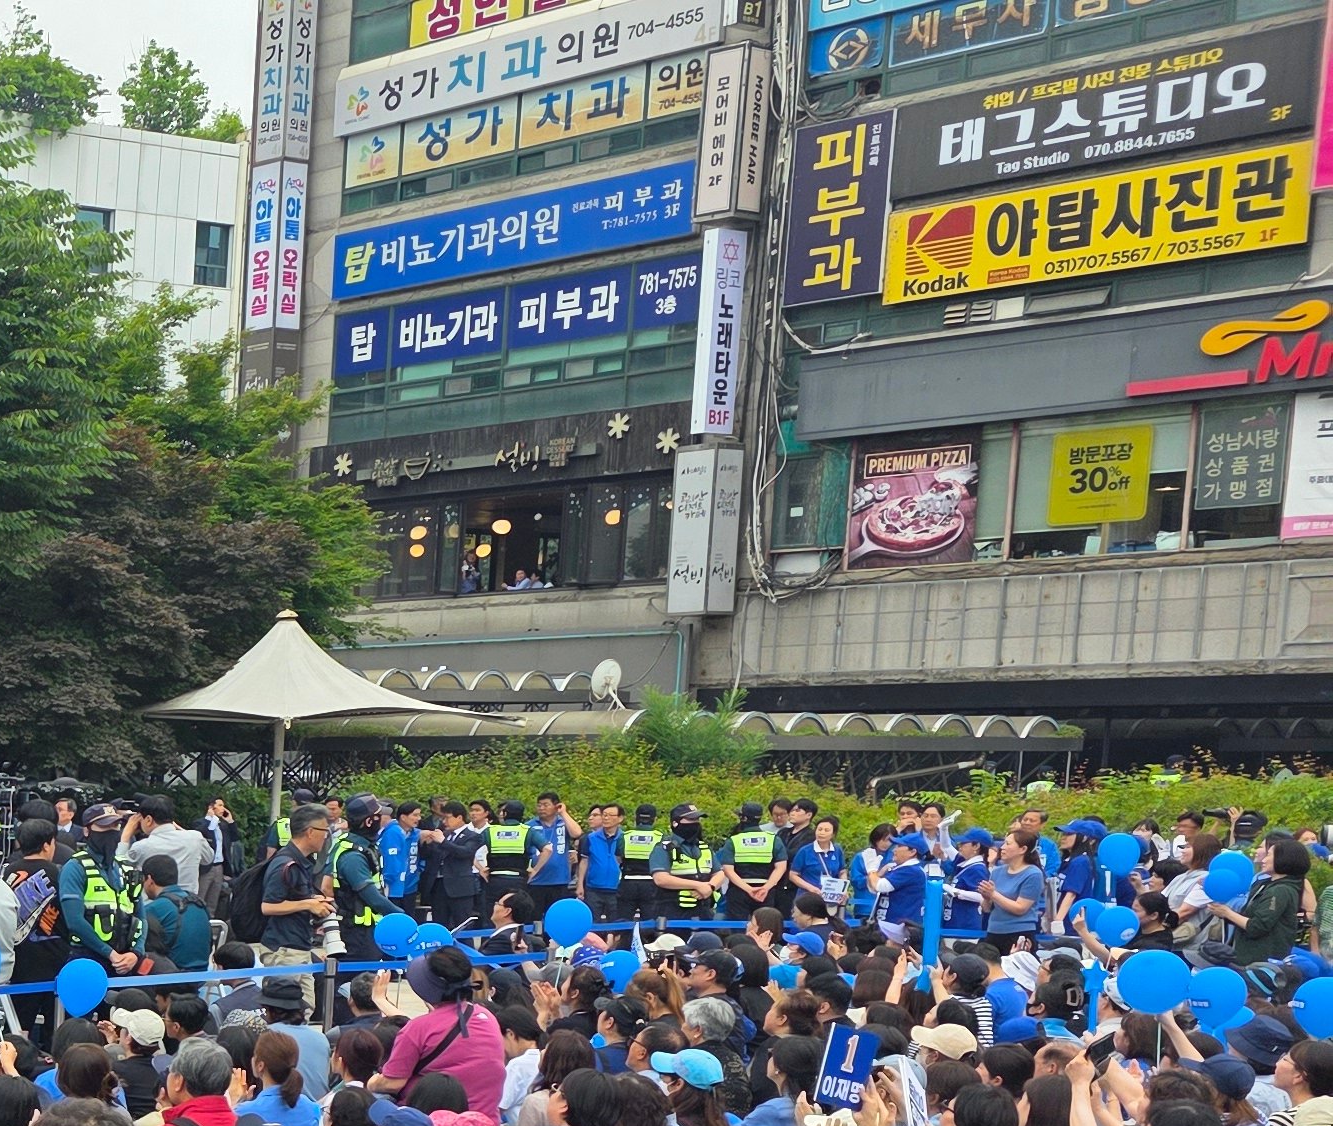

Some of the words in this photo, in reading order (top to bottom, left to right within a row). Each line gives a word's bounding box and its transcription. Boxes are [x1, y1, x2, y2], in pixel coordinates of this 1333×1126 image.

[628, 7, 704, 40] 704-4555
[743, 1, 762, 18] B1
[983, 90, 1014, 110] 취업
[1031, 79, 1080, 100] 프로필
[1081, 71, 1115, 89] 사진
[1118, 61, 1153, 81] 전문
[1155, 48, 1224, 74] 스튜디오
[714, 76, 730, 127] 모어비
[750, 75, 764, 143] MOREBE
[938, 61, 1268, 166] 태그스튜디오
[1270, 104, 1292, 122] 3F
[711, 133, 726, 167] 헤어
[747, 146, 759, 185] HAIR
[996, 159, 1021, 175] Tag
[1024, 151, 1071, 170] Studio
[1084, 127, 1196, 160] 070.8844.7655
[603, 179, 684, 212] 피부과
[709, 175, 723, 187] 2F
[602, 210, 658, 230] T:781-7575
[664, 203, 681, 220] 3F
[803, 123, 867, 291] 피부과
[986, 154, 1293, 258] 야탑사진관
[344, 242, 376, 284] 탑
[381, 204, 561, 274] 비뇨기과의원
[1259, 227, 1280, 244] 1F
[1044, 246, 1151, 276] 031)707.5567
[1167, 232, 1245, 258] 703.5567
[251, 250, 271, 317] 오락실
[281, 248, 298, 315] 오락실
[639, 265, 697, 296] 781-7575
[903, 273, 970, 298] Kodak
[655, 294, 678, 315] 3층
[351, 322, 377, 363] 탑
[399, 301, 498, 353] 비뇨기과
[518, 280, 620, 334] 피부과
[713, 294, 734, 406] 노래타운
[708, 410, 730, 426] B1F
[1069, 443, 1134, 465] 방문포장
[1206, 427, 1280, 453] 성남사랑
[868, 453, 928, 474] PREMIUM
[930, 449, 967, 467] PIZZA
[1205, 453, 1275, 477] 상품권
[1108, 476, 1131, 491] off
[1203, 477, 1273, 500] 가맹점
[841, 1034, 860, 1074] 1
[821, 1076, 864, 1104] 이재명
